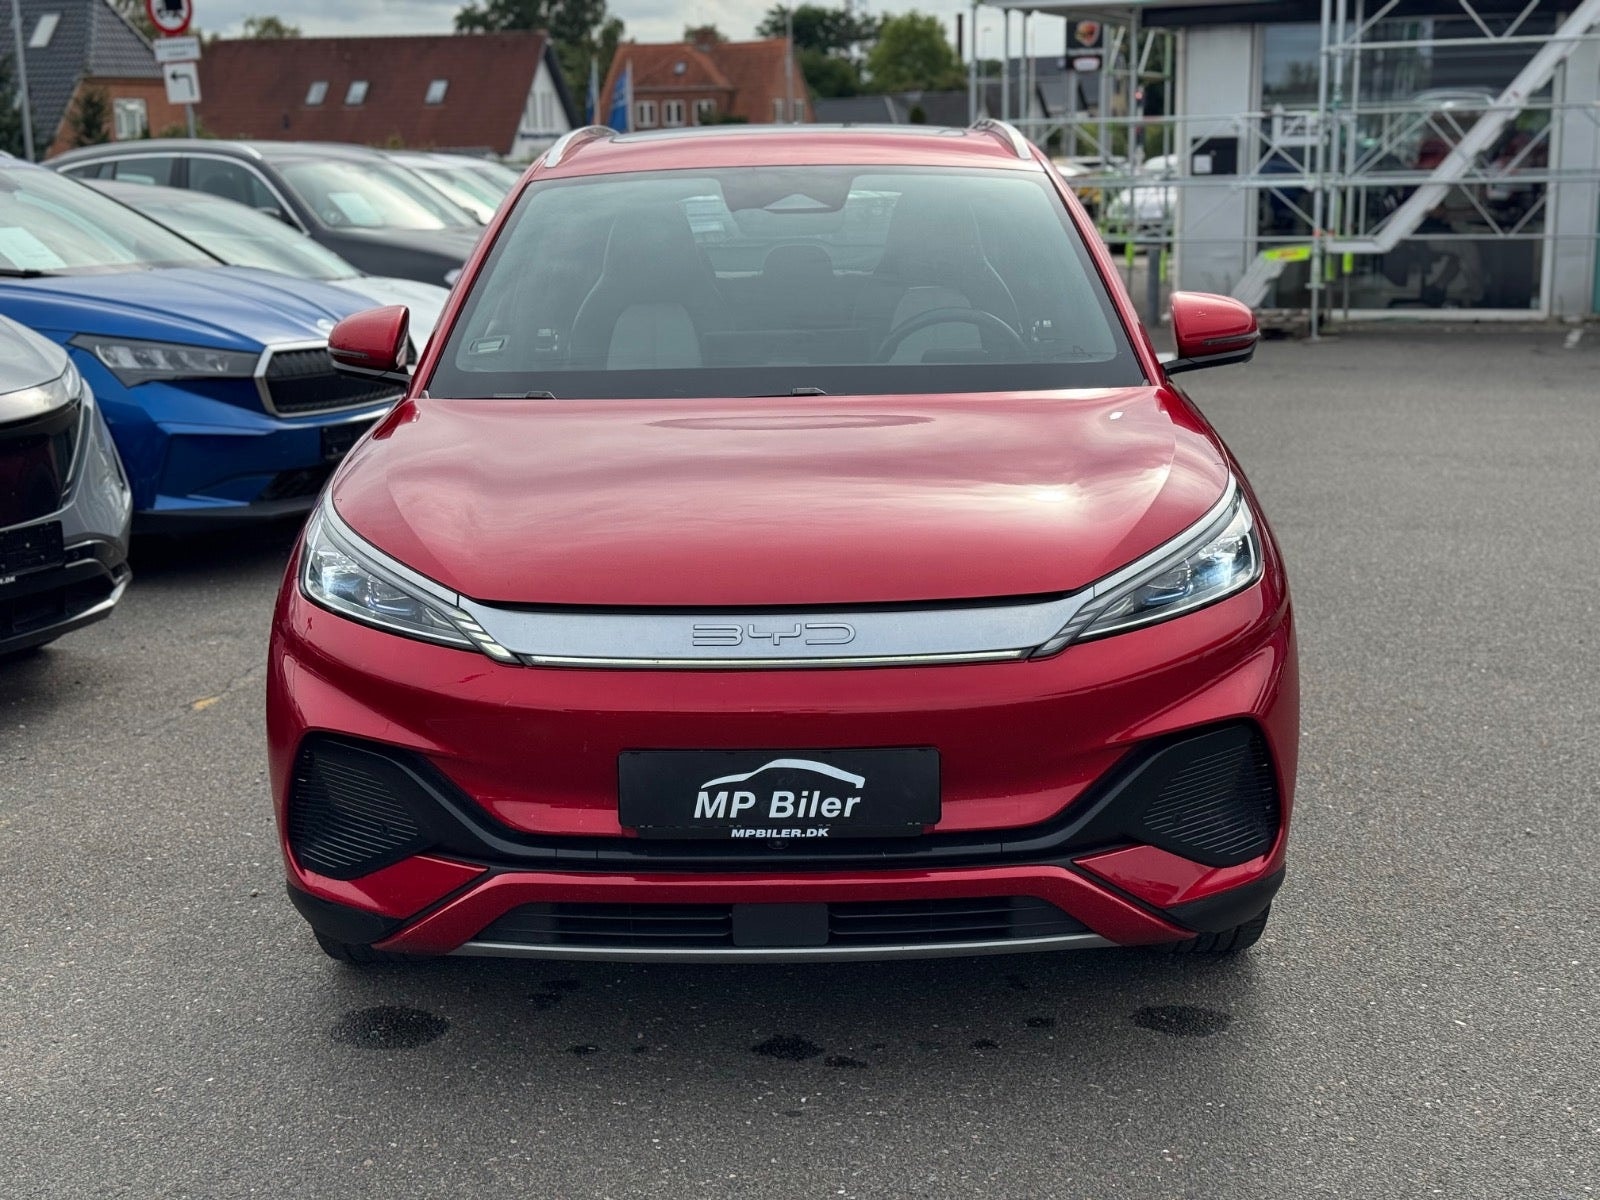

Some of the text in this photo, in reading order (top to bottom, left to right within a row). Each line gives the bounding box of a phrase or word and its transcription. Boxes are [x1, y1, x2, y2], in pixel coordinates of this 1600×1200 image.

[692, 623, 856, 646] BYD
[693, 790, 861, 819] MP Biler
[731, 828, 830, 838] MPBILER.DK
